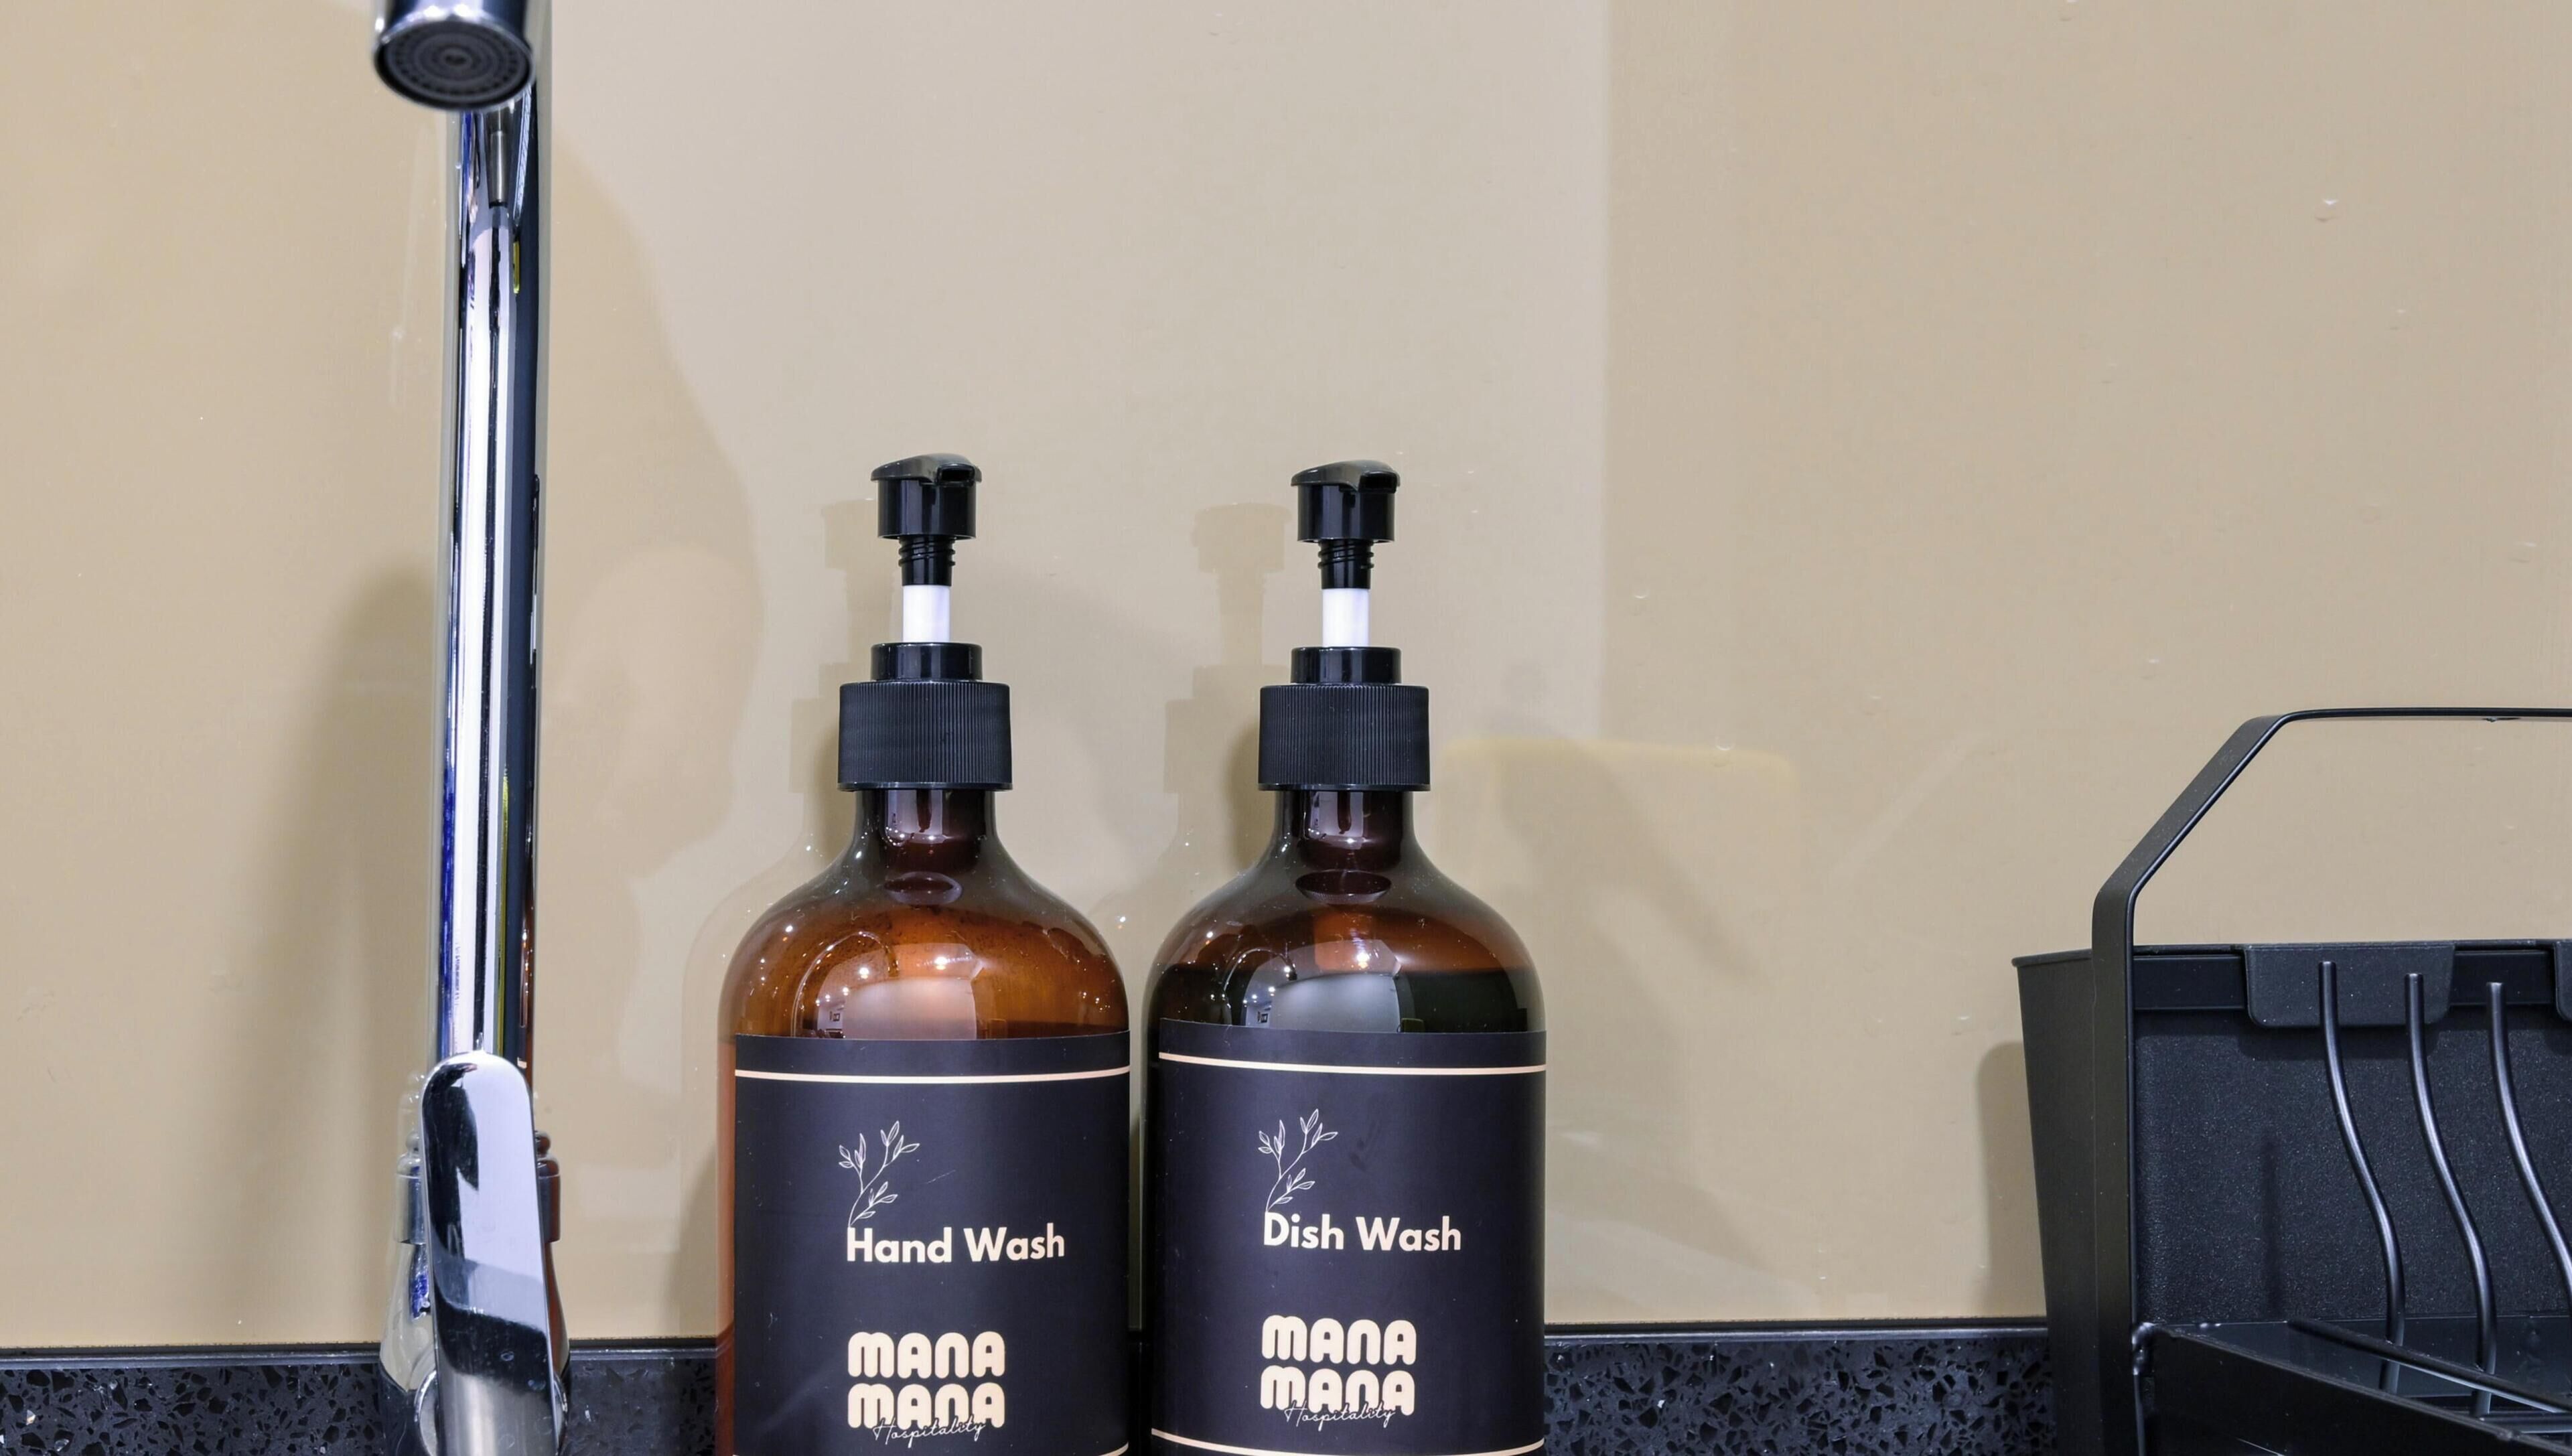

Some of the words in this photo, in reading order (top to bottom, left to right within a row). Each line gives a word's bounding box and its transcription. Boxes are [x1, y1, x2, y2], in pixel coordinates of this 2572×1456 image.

[847, 1227, 952, 1263] Hand
[964, 1222, 1065, 1262] Wash
[1263, 1211, 1344, 1250] Dish
[1356, 1216, 1461, 1251] Wash
[848, 1331, 1005, 1379] MANA
[1261, 1314, 1417, 1365] MANA
[873, 1415, 986, 1448] Hospitality
[1283, 1400, 1395, 1431] Hospitality
